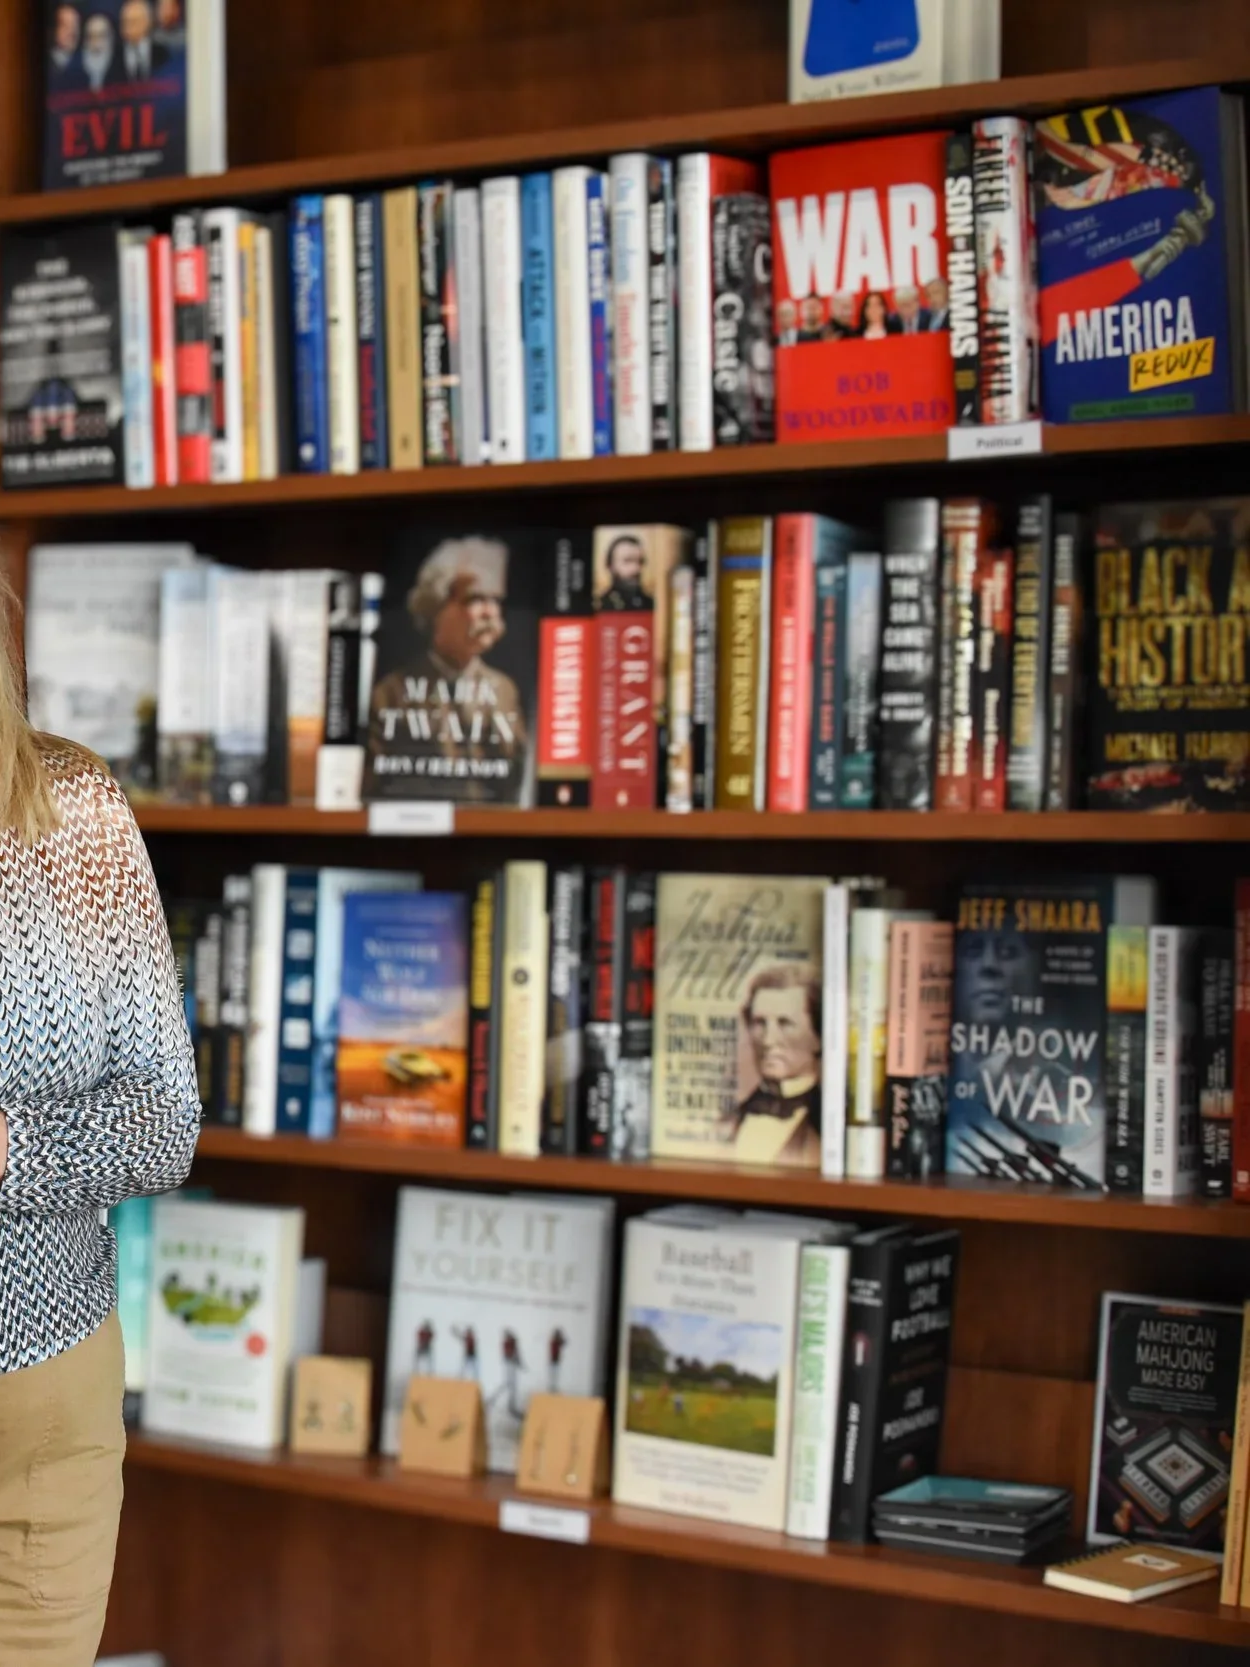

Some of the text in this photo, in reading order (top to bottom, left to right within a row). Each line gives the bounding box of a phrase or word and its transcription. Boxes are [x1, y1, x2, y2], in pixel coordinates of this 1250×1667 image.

[61, 103, 168, 158] EVIL
[777, 183, 940, 298] WAR
[529, 249, 546, 318] ATTACK
[946, 177, 980, 359] SON HAMAS
[714, 291, 745, 392] Caste
[1056, 296, 1196, 364] AMERICA
[530, 346, 547, 415] WITHIN
[1134, 342, 1211, 384] REDUX
[836, 371, 891, 396] BOB
[782, 401, 949, 431] WOODWARD
[976, 436, 1023, 449] Political
[885, 555, 928, 574] WHEN
[1096, 547, 1213, 616] BLACK
[890, 578, 920, 599] THE
[1015, 577, 1039, 614] END
[889, 603, 920, 624] SEA
[1015, 616, 1038, 639] OF
[729, 578, 760, 757] FRONTIERSMEN
[1099, 614, 1250, 688] HISTOR
[405, 676, 498, 706] MARK
[551, 625, 583, 760] WASHINGTON
[954, 638, 975, 714] Flower
[1013, 641, 1038, 746] EVERYTHING
[619, 626, 649, 776] GRANT
[378, 708, 518, 744] TWAIN
[953, 715, 972, 776] Moon
[1105, 732, 1178, 761] MICHAEL
[374, 754, 509, 777] RON CHERNOW
[678, 887, 799, 947] Joshua
[957, 898, 1102, 932] JEFF SHAARA
[1154, 952, 1168, 1016] DESPERATE
[666, 1013, 737, 1032] CIVIL WAR
[1011, 996, 1044, 1015] THE
[666, 1034, 738, 1056] UNIONIST
[950, 1022, 1098, 1062] SHADOW
[1119, 1050, 1130, 1086] WIDE
[954, 1068, 1094, 1127] OF WAR
[1118, 1087, 1129, 1121] WIDE
[1153, 1077, 1165, 1155] HAMPTON SIDES
[1203, 1123, 1218, 1168] SWIFT
[1217, 1128, 1230, 1164] EARL
[435, 1202, 565, 1256] FIX IT
[412, 1250, 581, 1293] YOURSELF
[661, 1241, 754, 1275] Baseball
[905, 1260, 931, 1284] WHY
[908, 1283, 941, 1311] LOVE
[891, 1310, 950, 1342] FOOTBALL
[1137, 1320, 1217, 1348] AMERICAN
[1135, 1343, 1216, 1373] MAHJONG
[1141, 1368, 1207, 1392] MADE EASY
